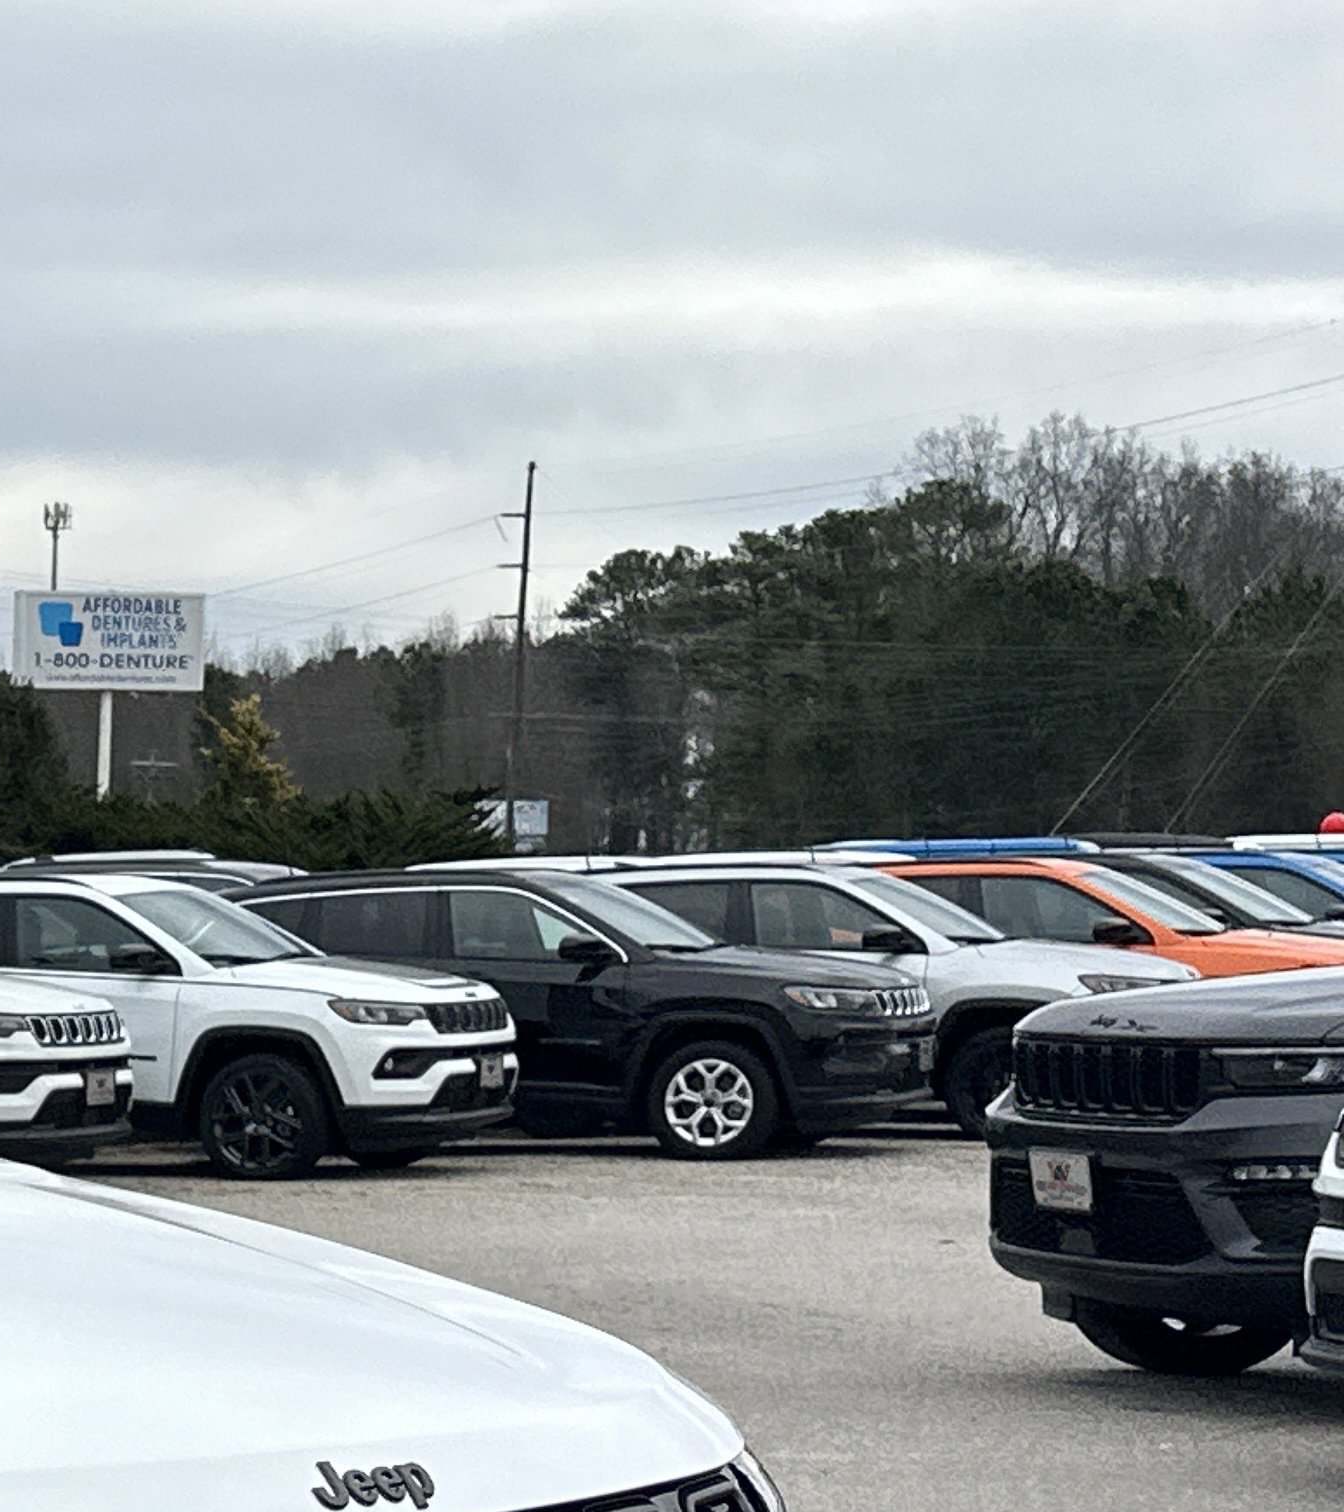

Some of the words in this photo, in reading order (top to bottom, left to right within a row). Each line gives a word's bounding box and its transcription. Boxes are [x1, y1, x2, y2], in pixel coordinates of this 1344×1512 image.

[82, 598, 182, 615] AFFORDABLE
[91, 615, 171, 632] DENTURES
[173, 616, 187, 632] &
[100, 633, 177, 650] IMPLANTS
[34, 651, 189, 669] 1-800-DENTURE
[311, 1461, 435, 1511] Jeep
